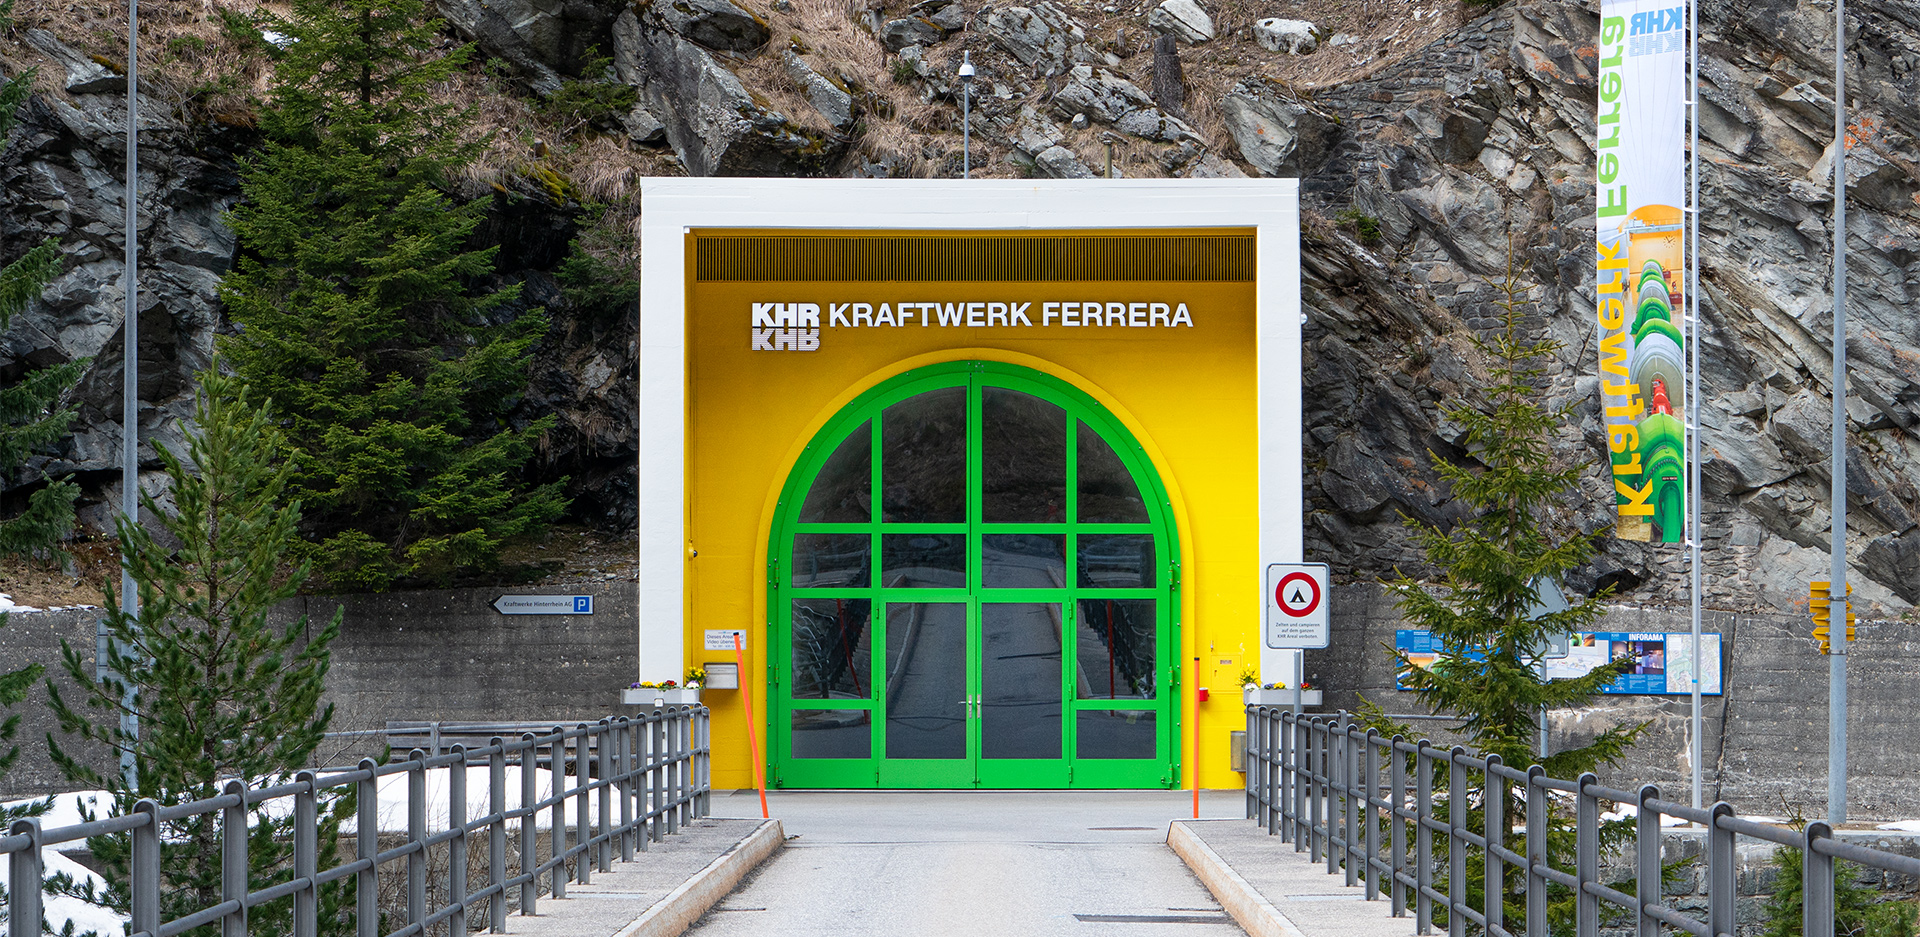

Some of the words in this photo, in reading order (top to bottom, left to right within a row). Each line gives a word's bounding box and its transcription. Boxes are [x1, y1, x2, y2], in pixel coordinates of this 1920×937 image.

[751, 302, 820, 327] KHR
[829, 302, 1032, 327] KRAFTWERK
[1042, 302, 1194, 327] FERRERA
[578, 599, 586, 611] P
[1628, 633, 1664, 641] INFORAMA
